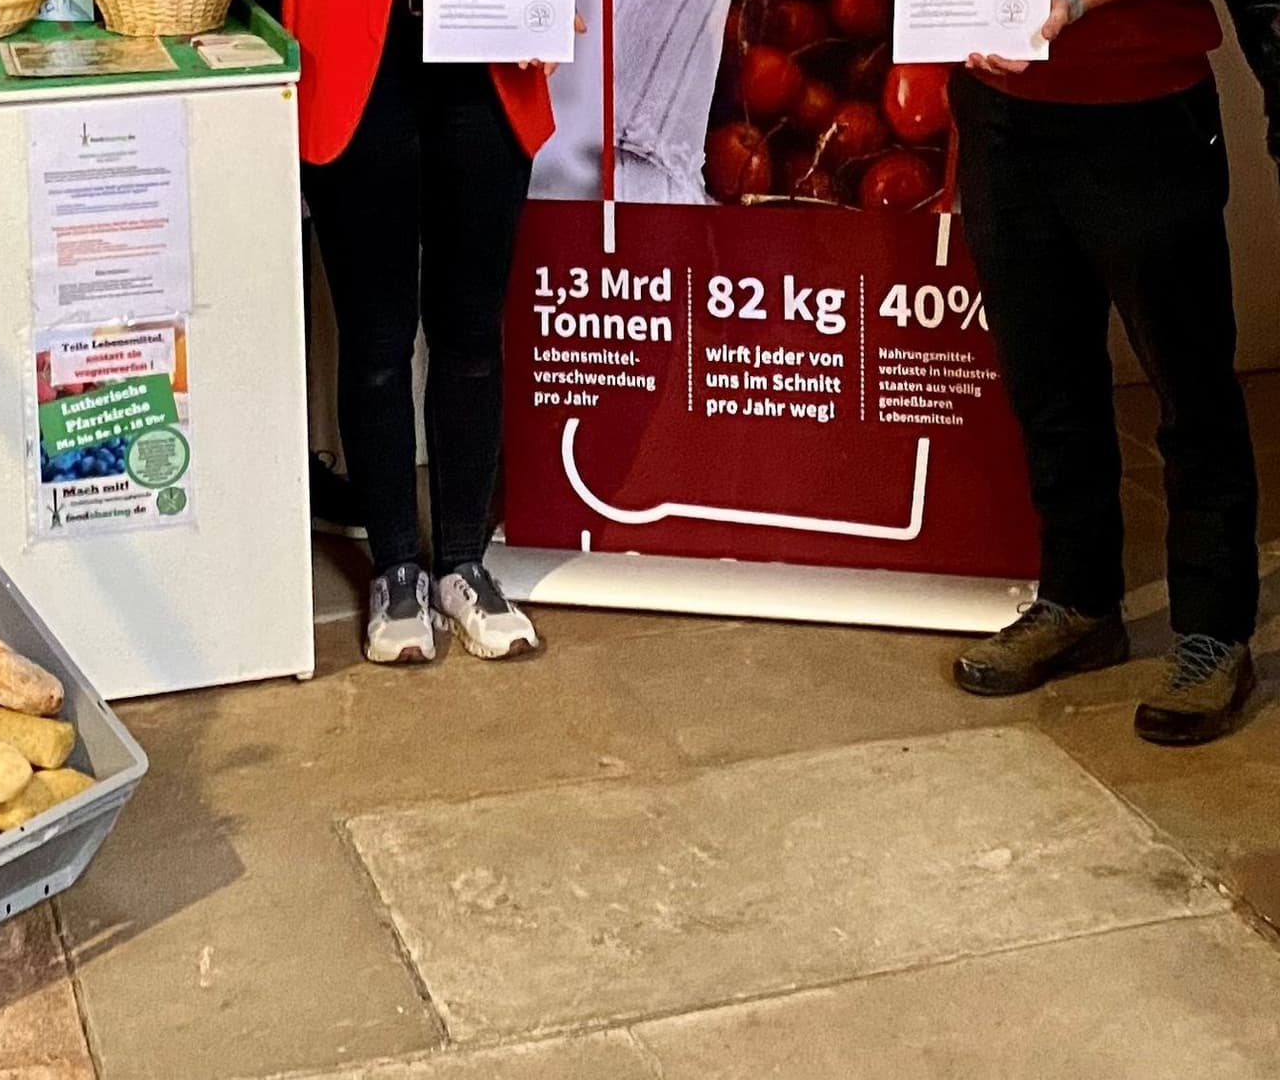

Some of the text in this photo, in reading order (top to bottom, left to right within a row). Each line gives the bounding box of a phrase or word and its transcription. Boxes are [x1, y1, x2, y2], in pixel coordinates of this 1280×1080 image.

[535, 266, 672, 305] 1,3 Mrd
[707, 274, 846, 334] 82 kg
[878, 284, 989, 331] 40%
[533, 305, 672, 341] Tonnen
[533, 346, 641, 366] Lebensmittel-
[705, 344, 844, 368] wirft jeder von
[878, 346, 975, 363] Nahrungsmittel-
[533, 369, 656, 392] verschwendung
[706, 371, 841, 393] uns im Schnitt
[878, 364, 1001, 380] verluste in Industrie-
[60, 384, 148, 416] Lutherische
[534, 390, 599, 406] pro Jahr
[878, 380, 982, 398] staaten aus völlig
[706, 397, 835, 423] pro Jahr weg!
[878, 396, 953, 409] genießbaren
[65, 401, 151, 433] Pfarrkirche
[879, 411, 964, 425] Lebensmitteln
[63, 484, 99, 498] Mach
